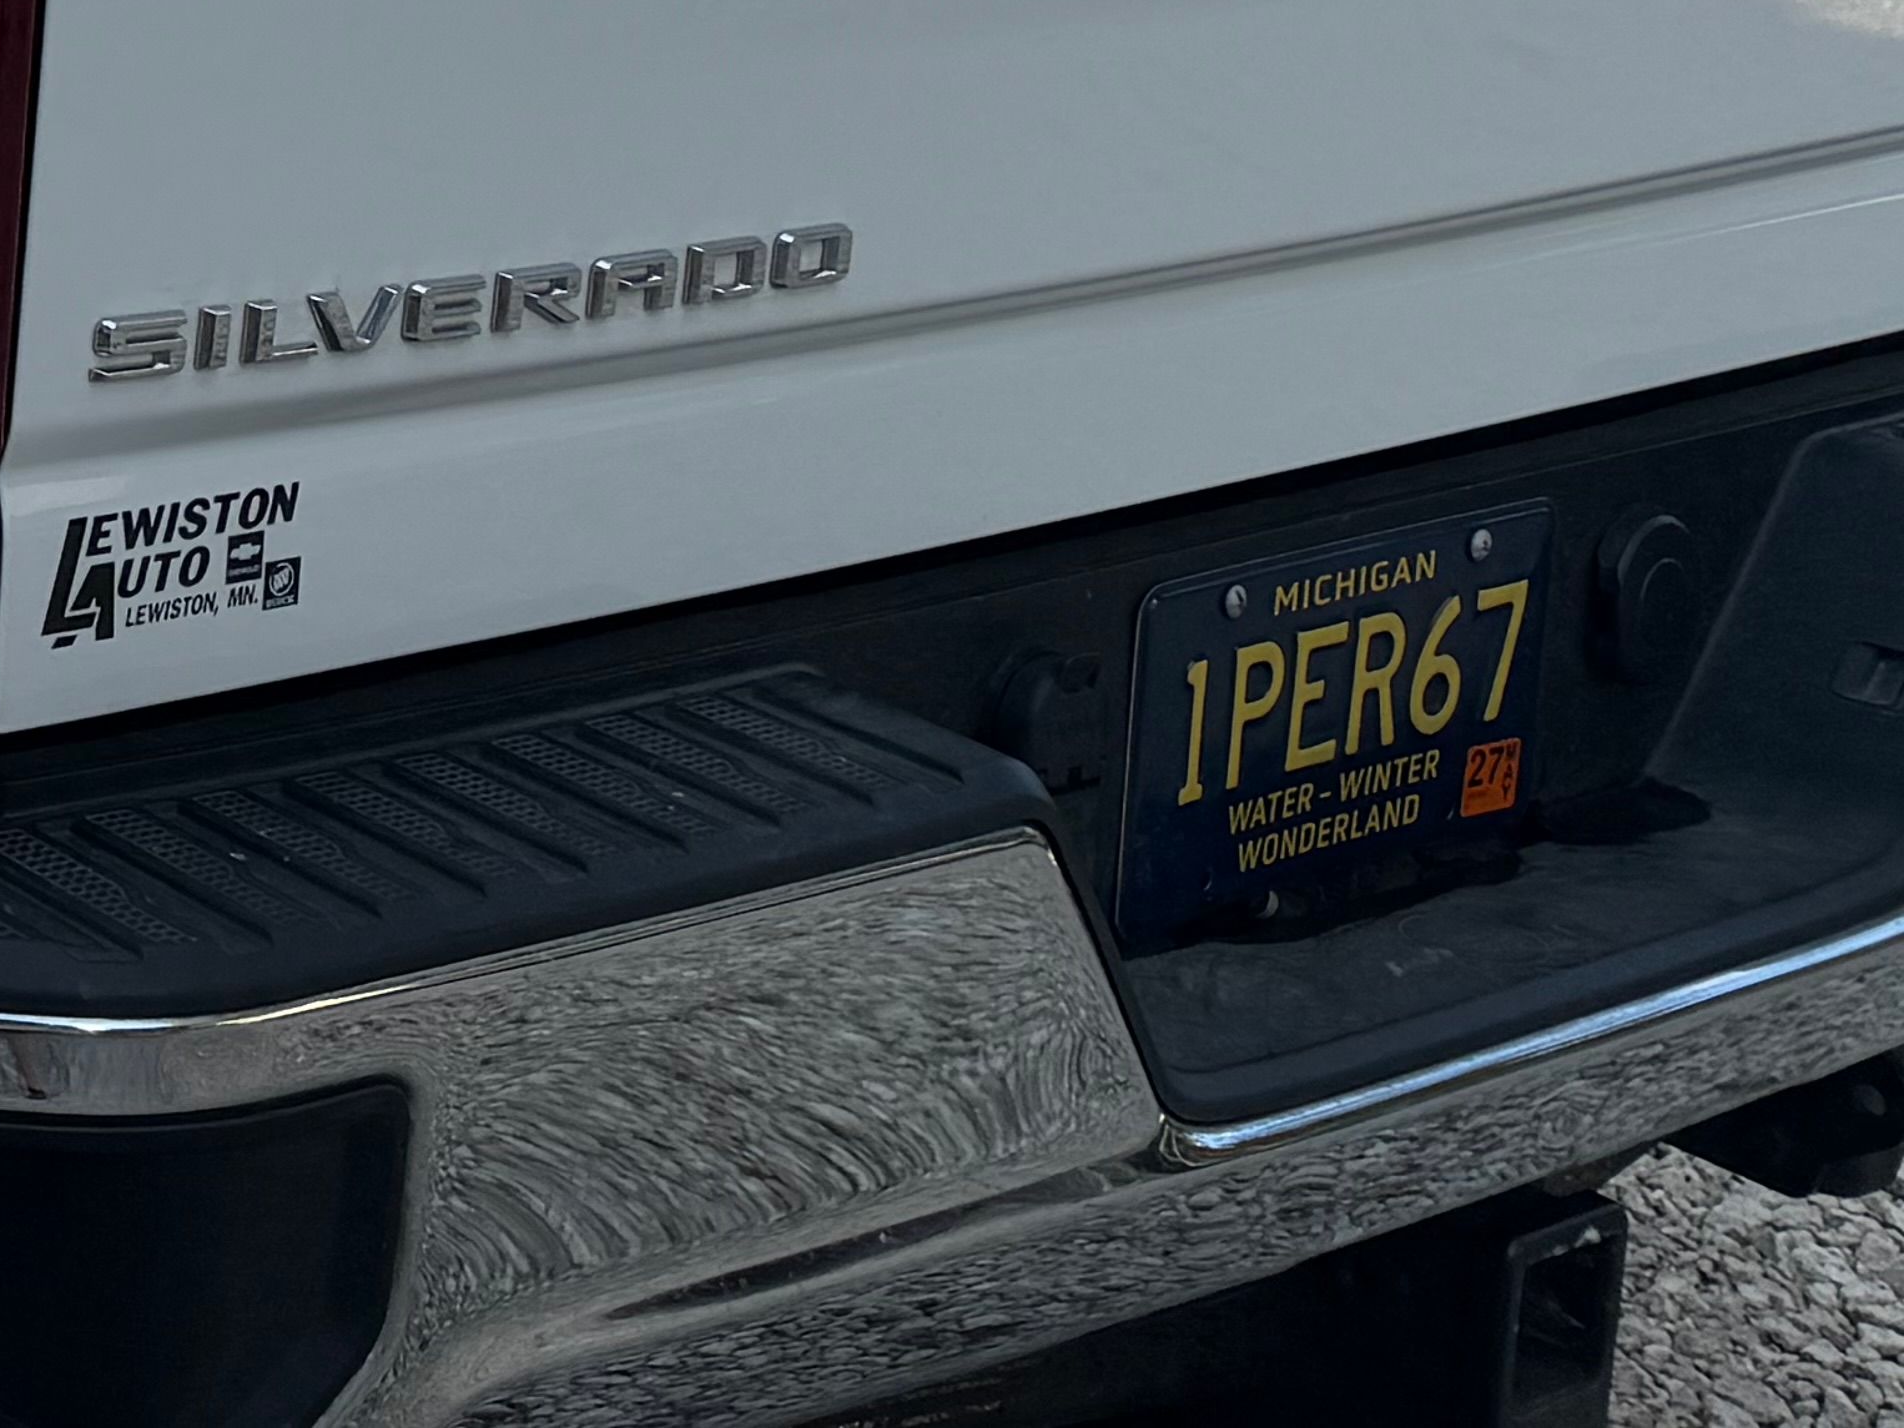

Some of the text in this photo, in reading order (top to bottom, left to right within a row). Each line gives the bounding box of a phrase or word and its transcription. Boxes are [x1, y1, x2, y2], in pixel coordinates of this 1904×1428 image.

[88, 222, 854, 384] SILVERADO
[41, 481, 300, 636] LEWISTON
[52, 545, 210, 649] AUTO
[1273, 549, 1438, 617] MICHIGAN
[125, 584, 258, 628] LEWISTON, MN.
[1177, 578, 1529, 807] 1PER67
[1467, 746, 1505, 789] 27
[1236, 793, 1421, 874] WONDERLAND
